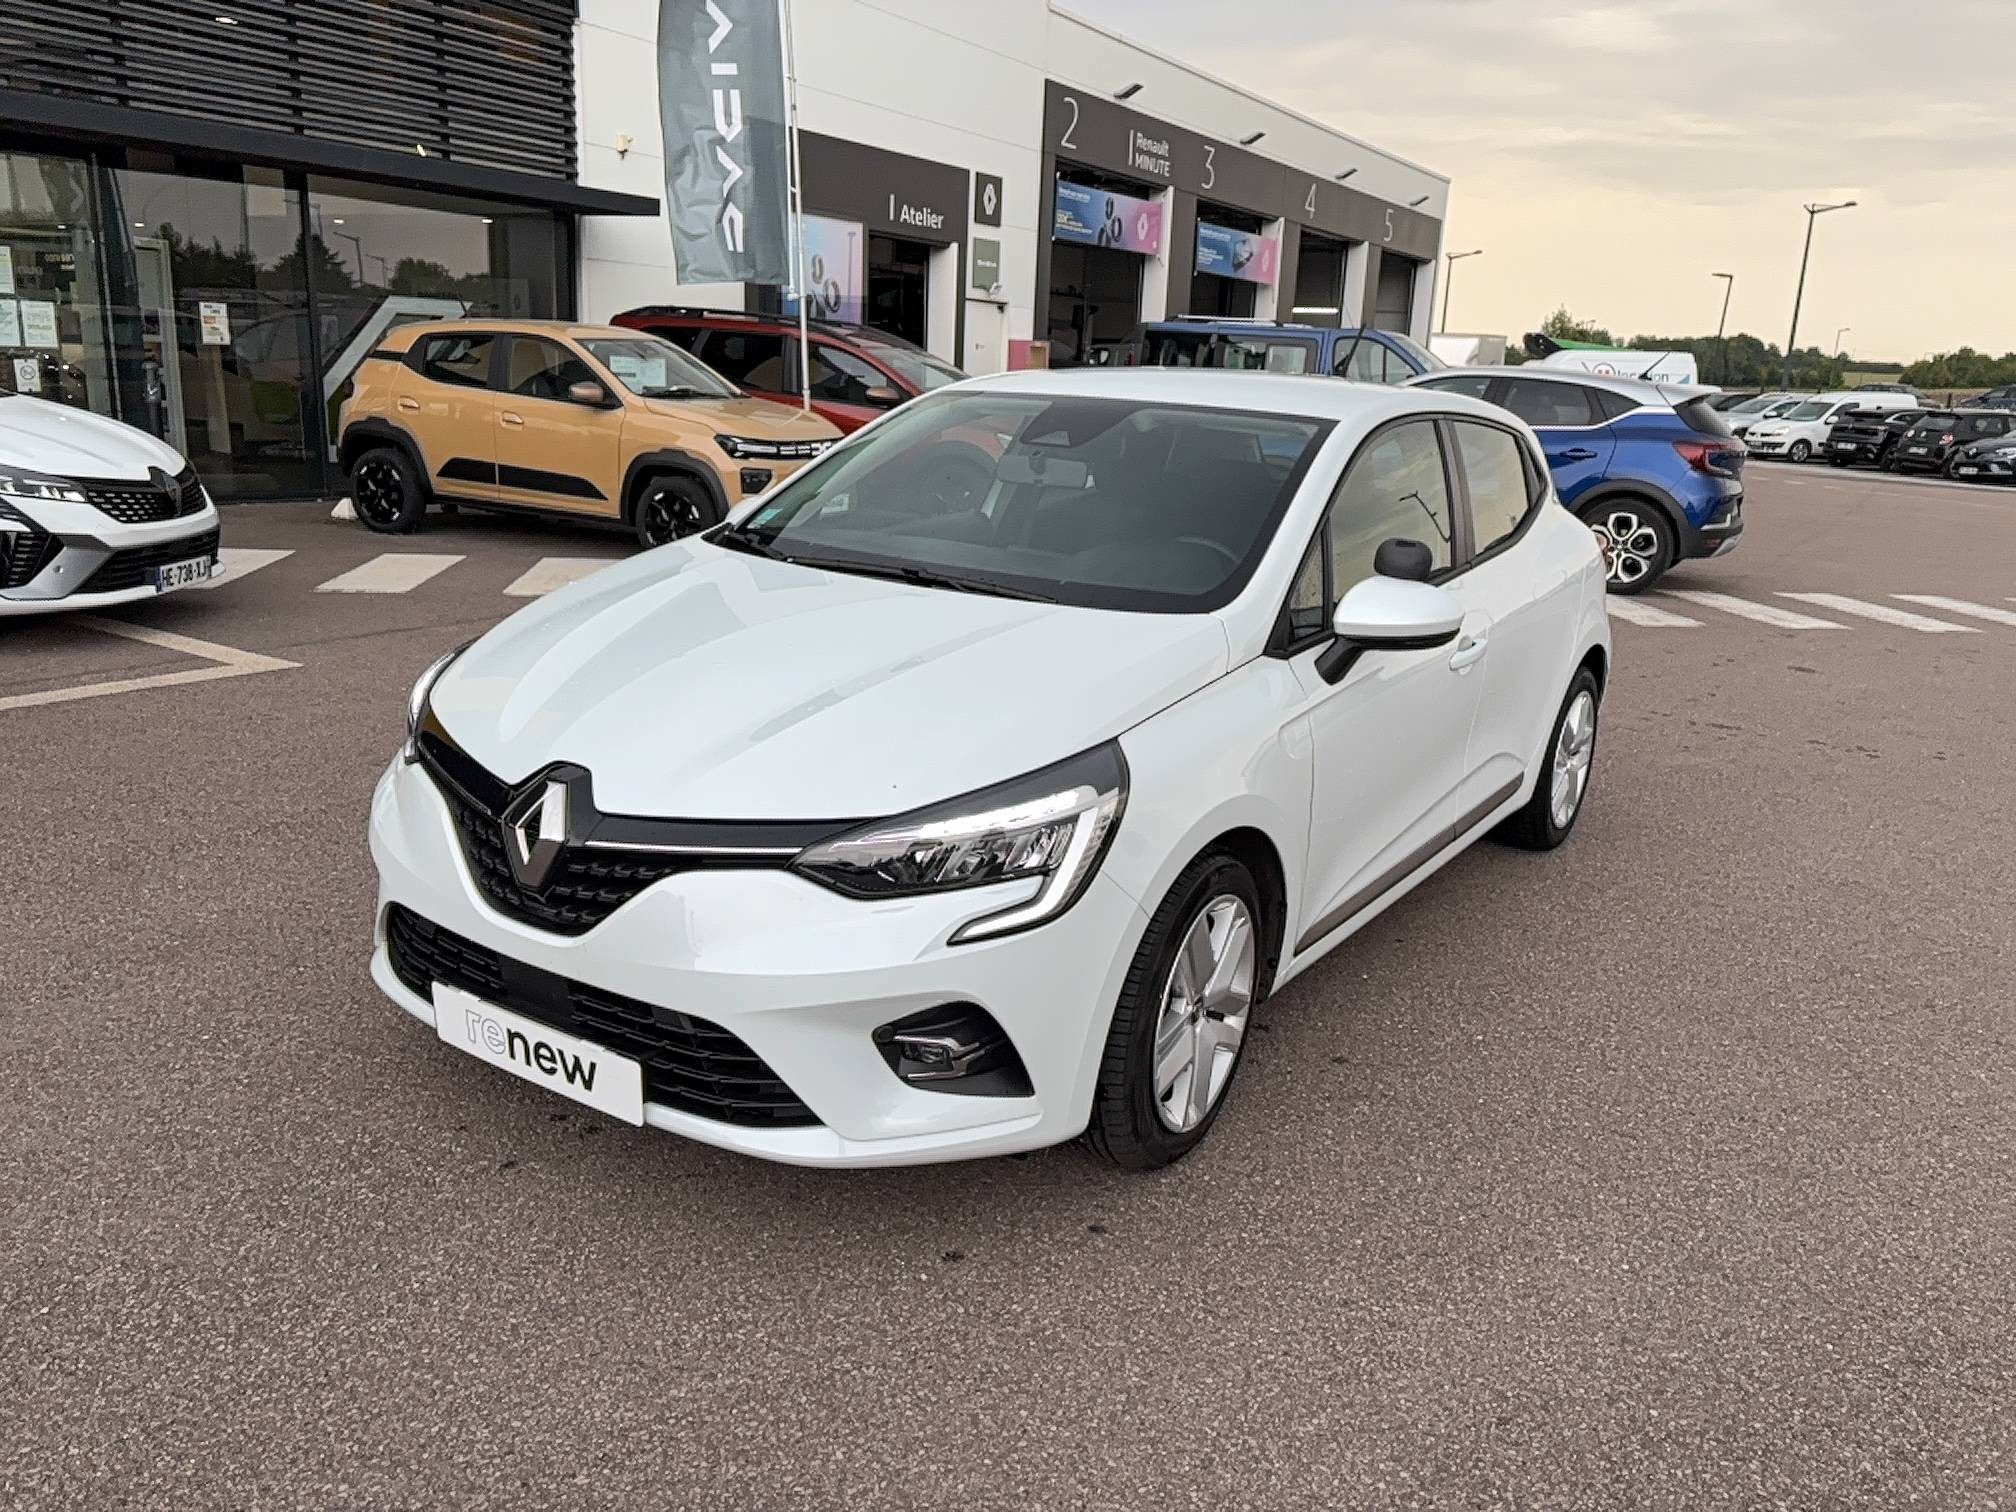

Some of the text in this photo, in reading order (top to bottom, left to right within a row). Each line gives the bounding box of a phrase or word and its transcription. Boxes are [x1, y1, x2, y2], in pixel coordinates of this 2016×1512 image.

[1061, 97, 1078, 149] 2
[1136, 132, 1169, 157] Renault
[1135, 152, 1170, 176] MINUTE
[1201, 145, 1215, 189] 3
[900, 204, 944, 229] Atelier
[1304, 183, 1317, 219] 4
[1384, 209, 1394, 242] 5
[465, 1008, 597, 1092] renew
